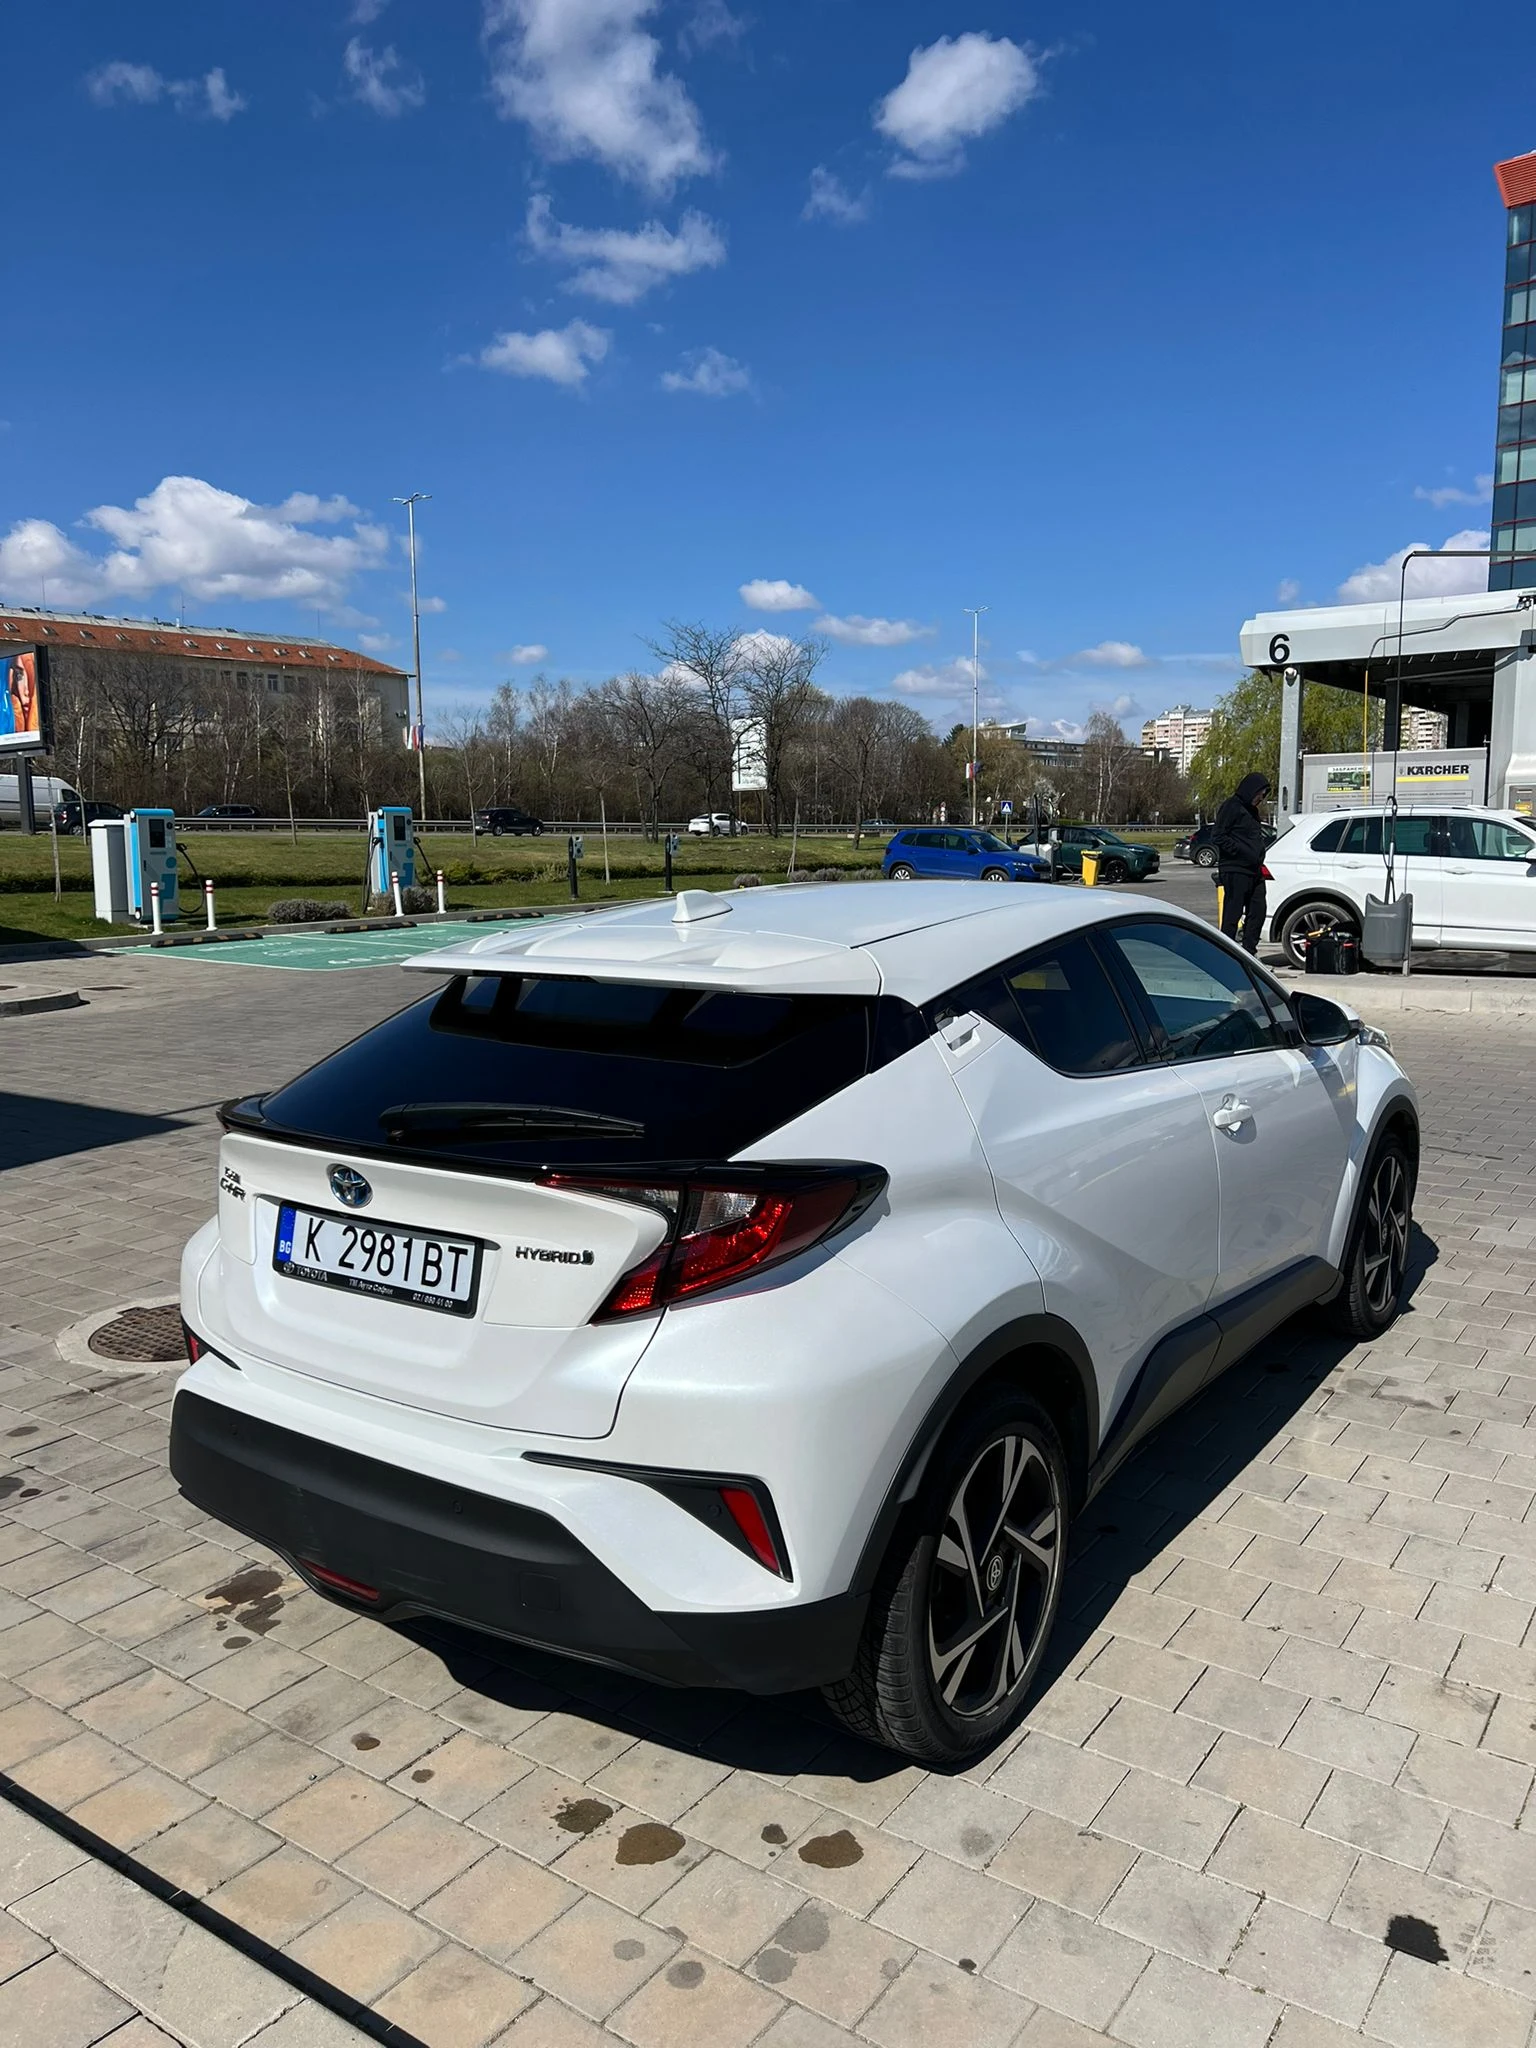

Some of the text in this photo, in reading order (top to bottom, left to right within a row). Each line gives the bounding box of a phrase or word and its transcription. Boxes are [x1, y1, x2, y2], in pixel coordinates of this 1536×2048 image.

[1269, 633, 1291, 664] 6
[1407, 764, 1469, 776] KÄRCHER
[279, 1239, 292, 1255] BG
[305, 1217, 326, 1263] K
[515, 1246, 581, 1265] HYBRID
[296, 1265, 328, 1282] TOYOTA
